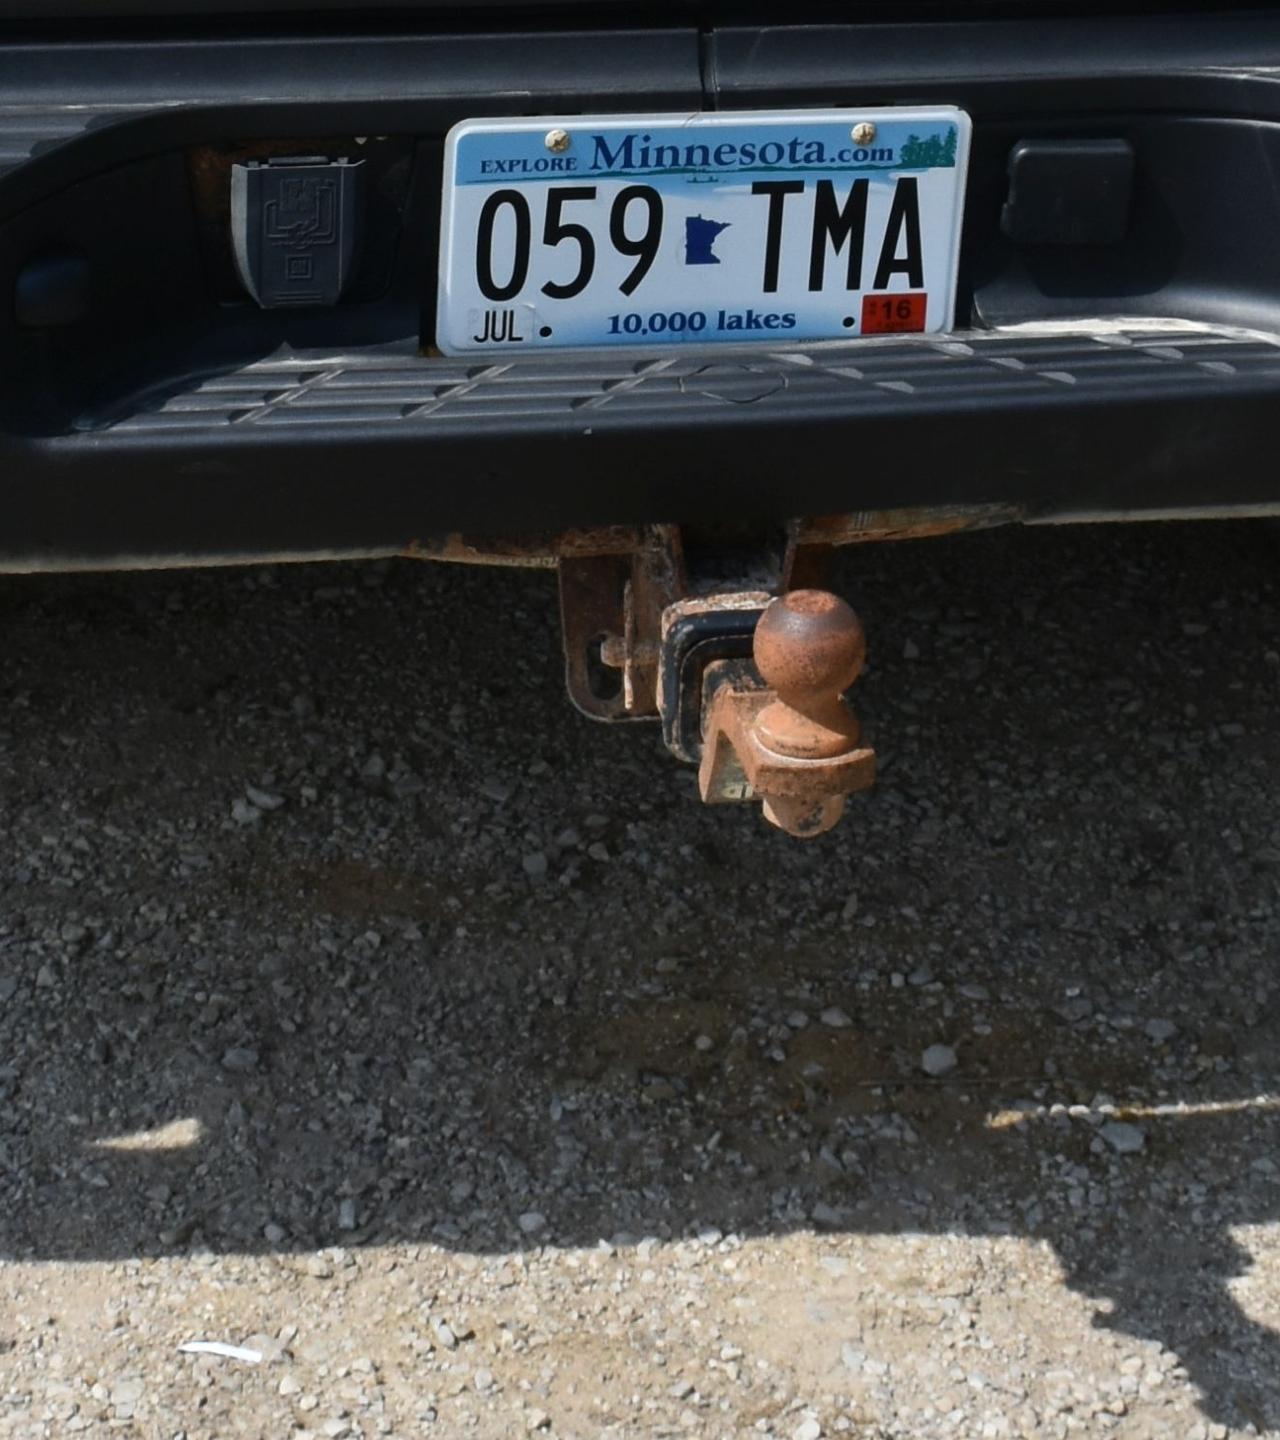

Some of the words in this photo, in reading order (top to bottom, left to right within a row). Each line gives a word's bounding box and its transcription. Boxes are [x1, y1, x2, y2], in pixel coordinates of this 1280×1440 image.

[480, 156, 578, 175] EXPLORE
[590, 133, 894, 171] Minnesota.com
[476, 185, 664, 301] 059
[751, 177, 924, 293] TMA
[607, 311, 706, 336] 10,000
[718, 309, 796, 331] lakes
[882, 299, 912, 320] 16
[473, 310, 523, 342] JUL
